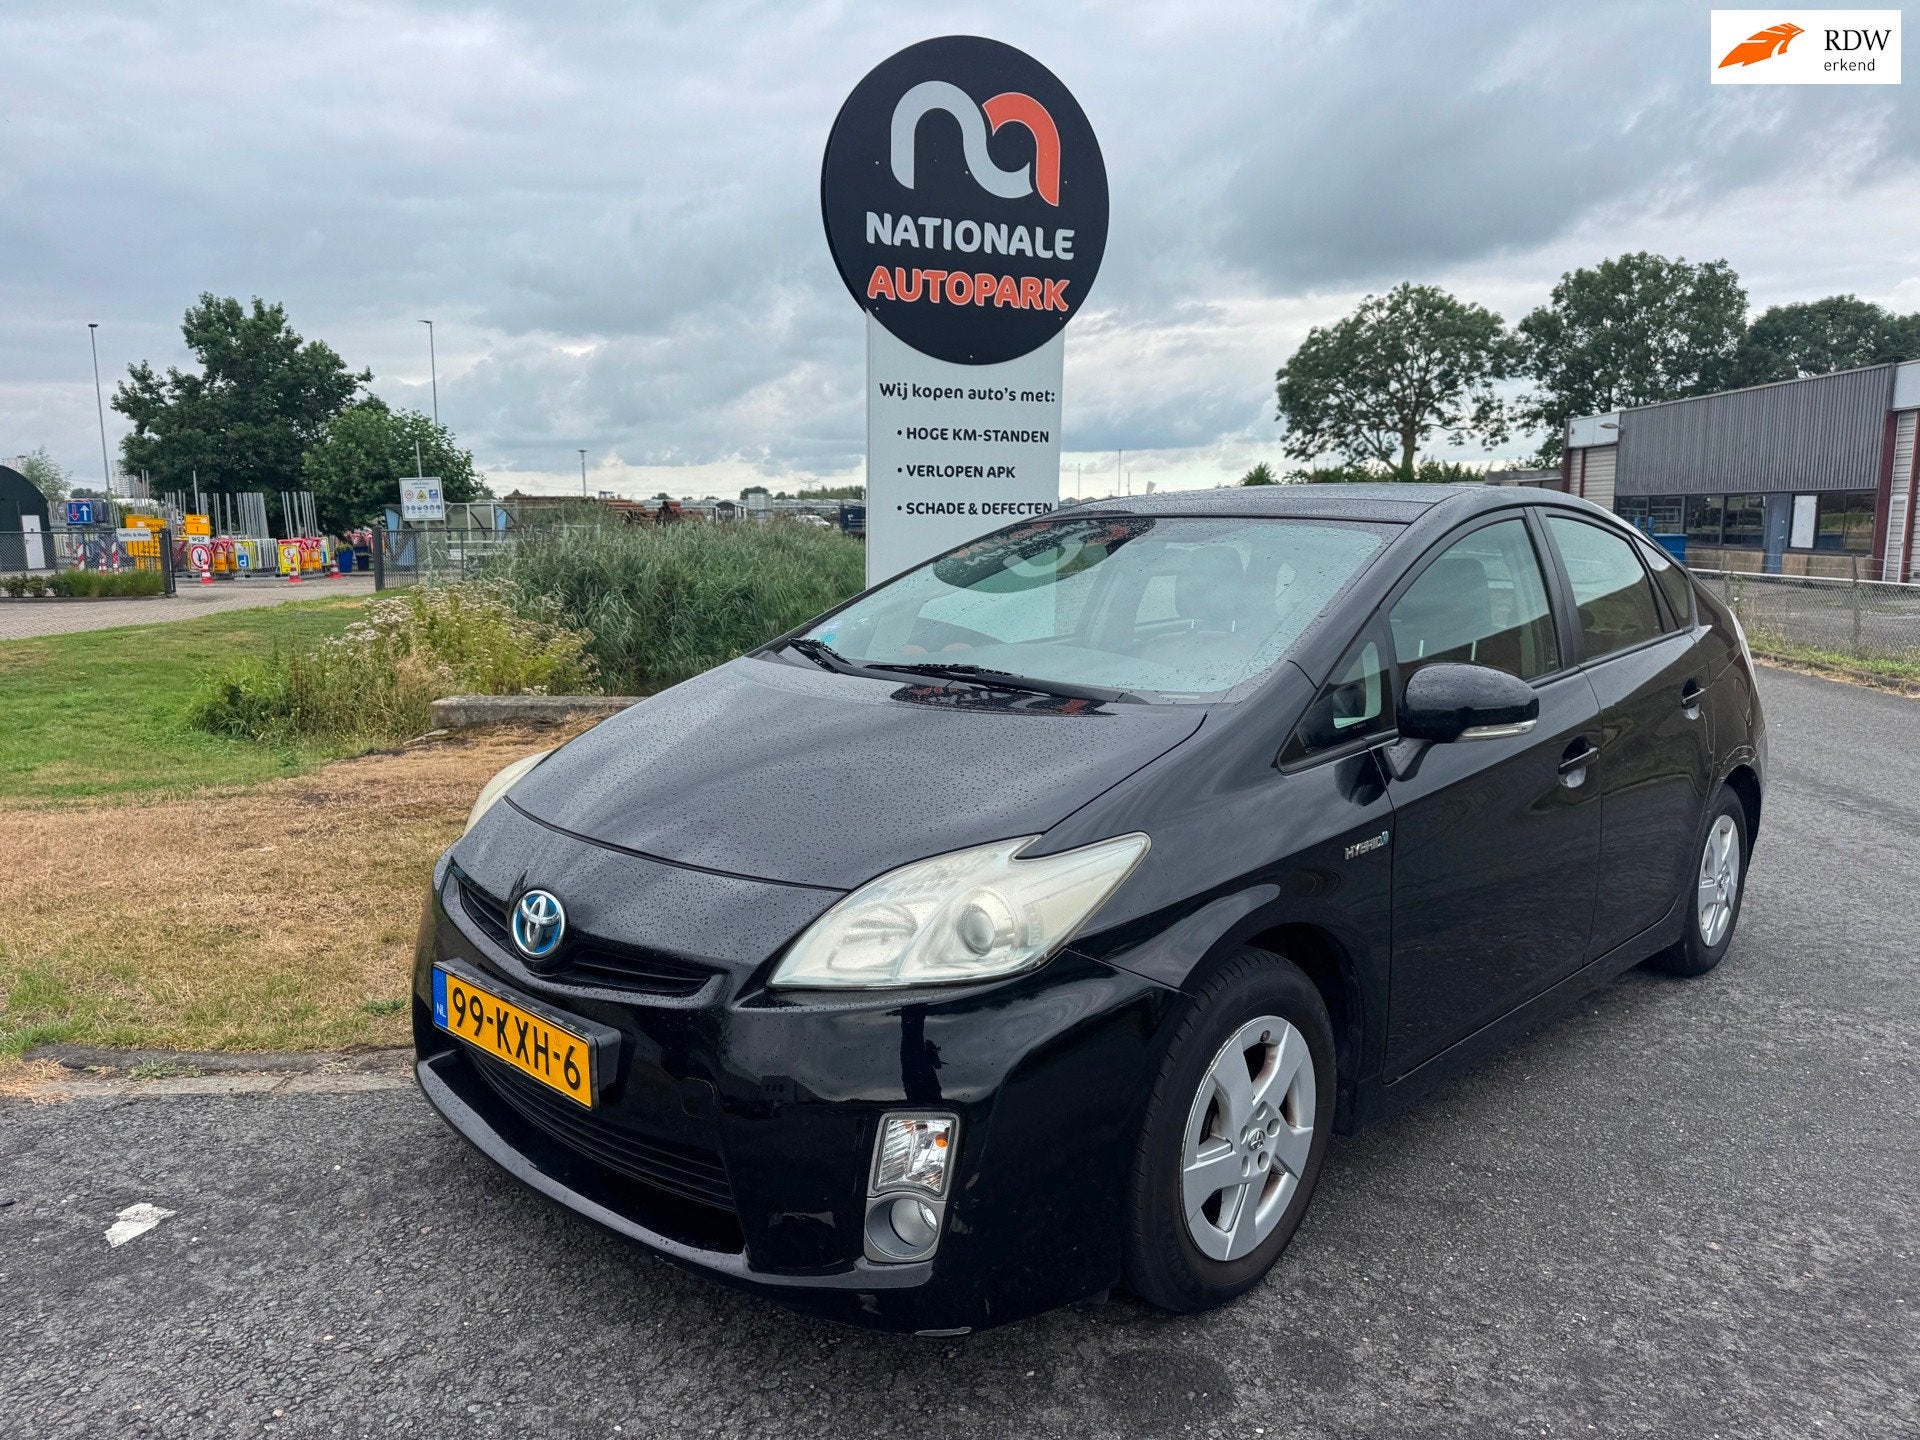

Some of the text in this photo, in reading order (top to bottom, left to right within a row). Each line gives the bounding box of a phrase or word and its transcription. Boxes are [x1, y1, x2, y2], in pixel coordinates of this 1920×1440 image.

[866, 211, 1075, 261] NATIONALE
[867, 265, 1071, 312] AUTOPARK
[879, 382, 1056, 403] Wij kopen auto's met:
[906, 427, 1050, 443] HOGE KM-STANDEN
[906, 464, 1016, 479] VERLOPEN APK
[906, 502, 1053, 515] SCHADE & DEFECTEN
[436, 1002, 447, 1018] NL
[452, 986, 581, 1091] 99-KXH-6
